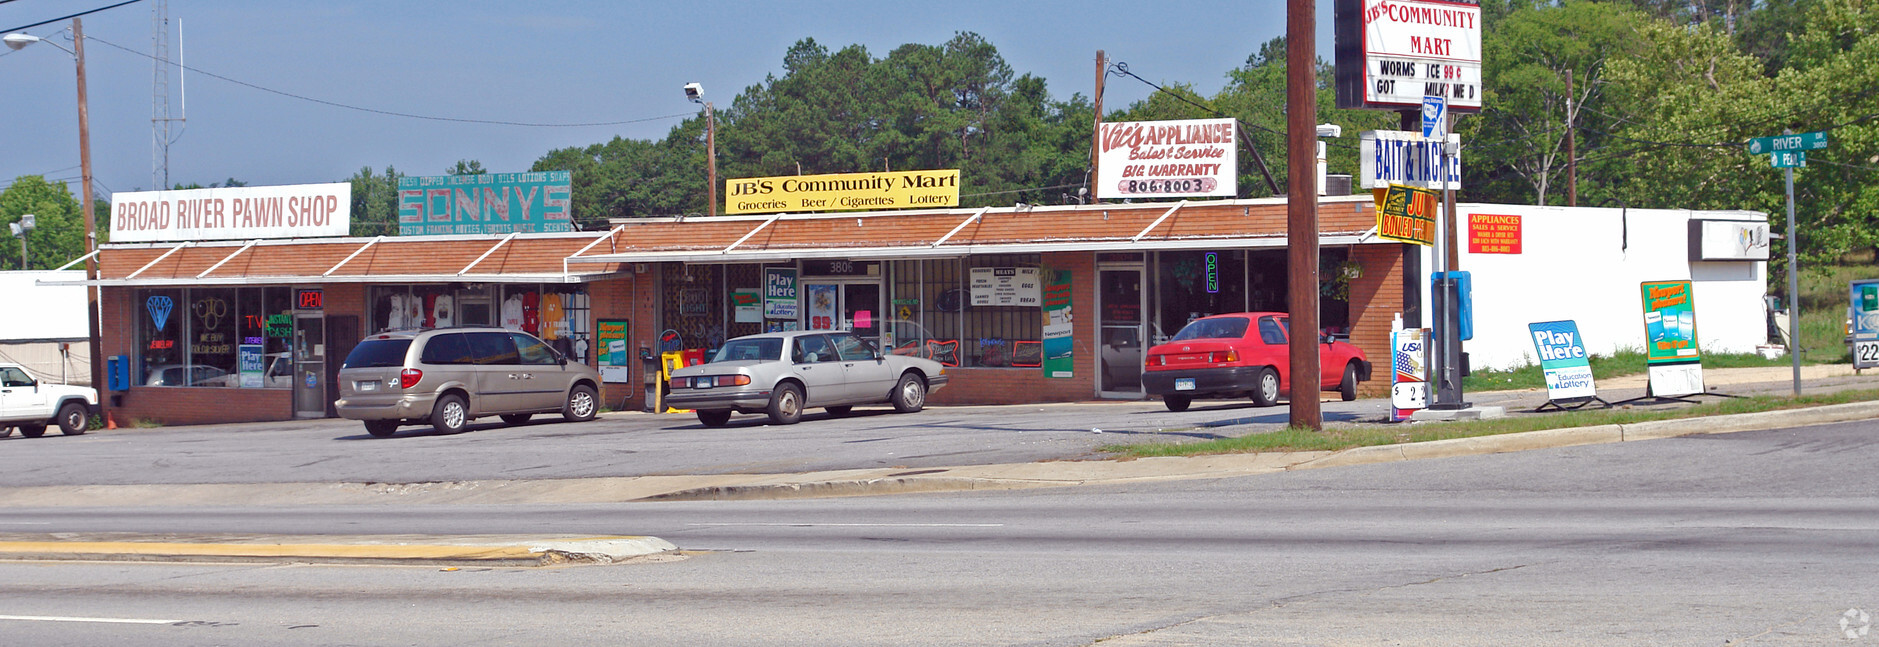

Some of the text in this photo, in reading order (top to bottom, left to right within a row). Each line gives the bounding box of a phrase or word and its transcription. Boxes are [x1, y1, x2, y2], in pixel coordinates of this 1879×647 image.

[1366, 1, 1474, 29] JB'S COMMUNITY
[1410, 35, 1452, 56] MART
[1380, 60, 1416, 77] WORMS
[1426, 63, 1440, 79] ICE
[1444, 65, 1453, 79] 99
[1377, 79, 1396, 95] GOT
[1453, 84, 1465, 99] WE
[1469, 85, 1475, 99] D
[1143, 123, 1232, 145] APPLIANCE
[1773, 137, 1802, 151] RIVER
[1127, 147, 1165, 161] Sales
[1173, 146, 1225, 160] Service
[1375, 138, 1403, 181] BAIT
[1405, 140, 1415, 181] &
[478, 173, 495, 185] BODY
[517, 172, 547, 183] LOTIONS
[550, 171, 571, 182] SOAPS
[1121, 163, 1222, 178] BIG WARRANTY
[731, 173, 958, 197] JB'S Community Mart
[398, 186, 571, 223] SONNYS
[737, 198, 787, 211] Groceries
[801, 197, 827, 208] Beer
[840, 196, 895, 209] Cigarettes
[909, 193, 951, 207] Lottery
[117, 194, 338, 231] BROAD RIVER PAWN SHOP
[1471, 215, 1520, 225] APPLIANCES
[399, 224, 425, 235] CUSTOM
[426, 223, 454, 235] FRAMING
[543, 222, 570, 233] SCENTS
[1383, 214, 1414, 239] BOILED
[830, 262, 853, 273] 3806
[1207, 254, 1217, 291] OPEN
[768, 273, 793, 290] Play
[301, 291, 323, 308] OPEN
[768, 287, 796, 299] Here
[774, 308, 795, 317] Lottery
[812, 316, 831, 330] 99
[269, 327, 292, 337] CASH
[1044, 329, 1071, 337] Newport
[1534, 330, 1575, 348] Play
[1402, 343, 1422, 352] USA
[1540, 344, 1584, 361] Here
[241, 351, 261, 362] Play
[242, 361, 264, 371] Here
[1558, 373, 1592, 382] Education
[1560, 380, 1590, 390] Lottery
